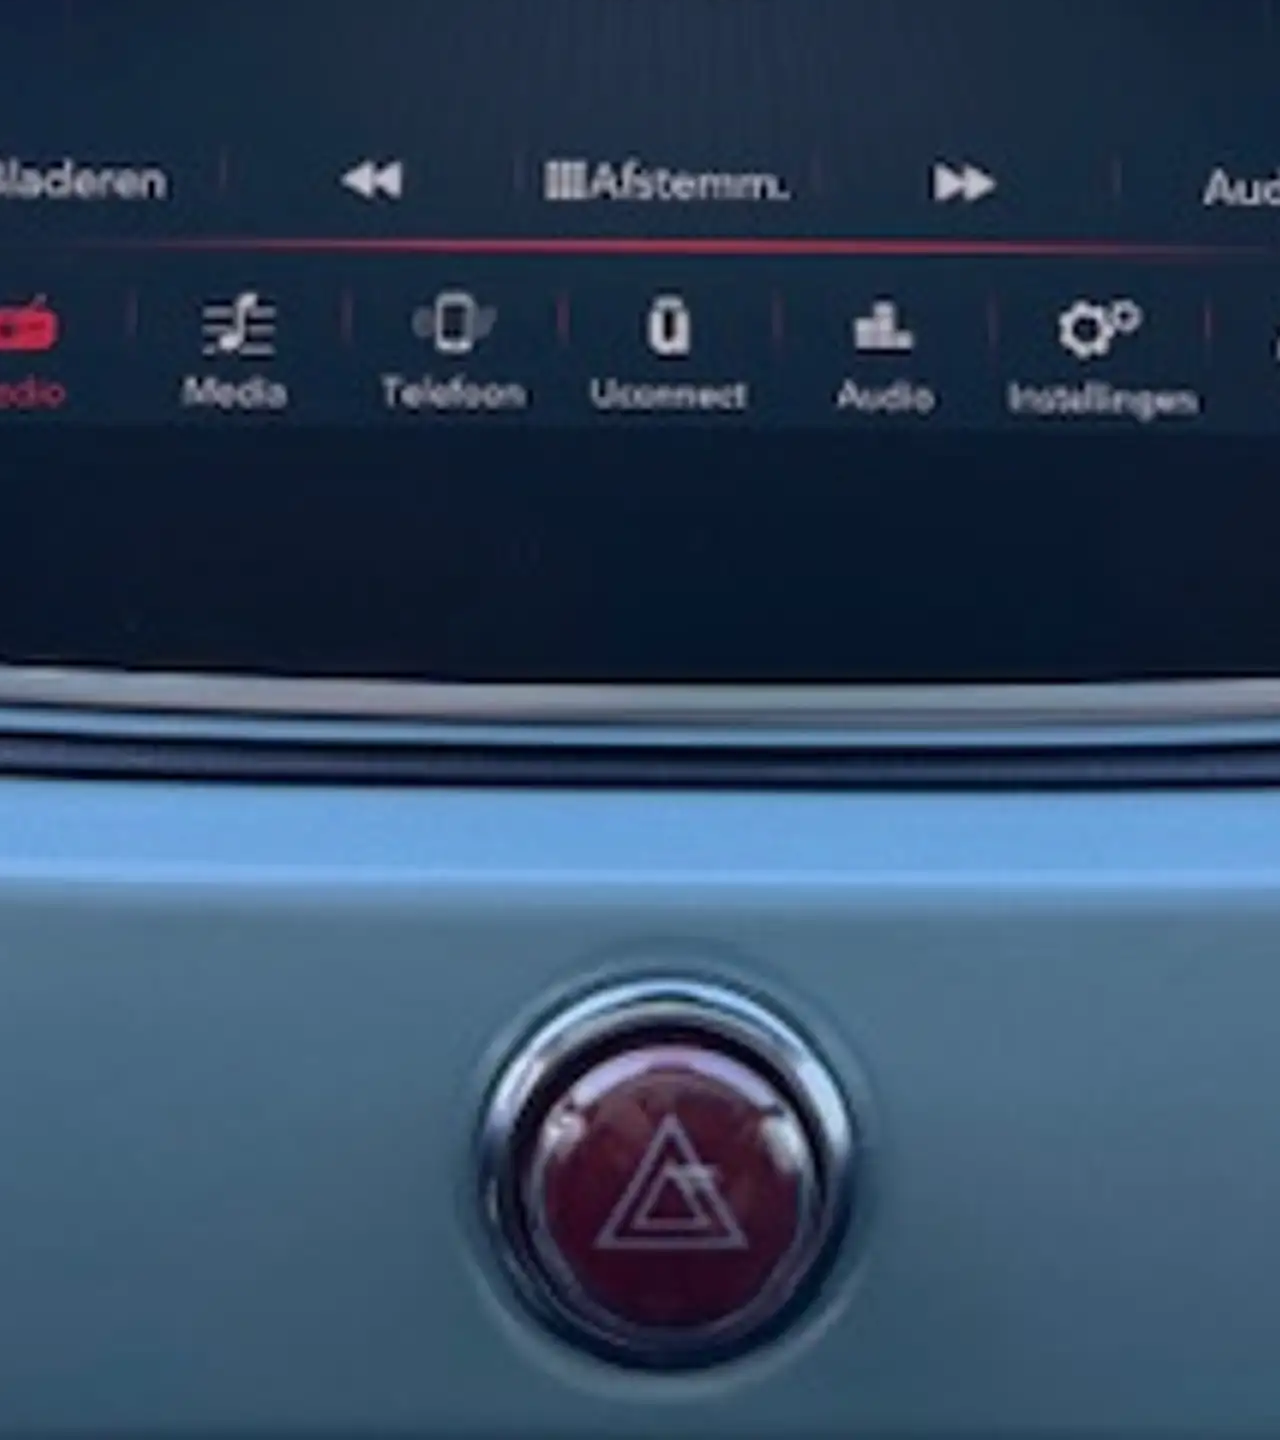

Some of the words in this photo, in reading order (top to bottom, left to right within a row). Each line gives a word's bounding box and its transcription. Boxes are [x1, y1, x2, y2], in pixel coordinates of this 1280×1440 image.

[591, 157, 792, 202] Afstemm.
[182, 375, 289, 410] Media
[381, 374, 527, 410] Telefoon
[589, 377, 748, 411] Uconnect
[836, 377, 937, 414] Audio
[1006, 379, 1201, 423] Instellingen
